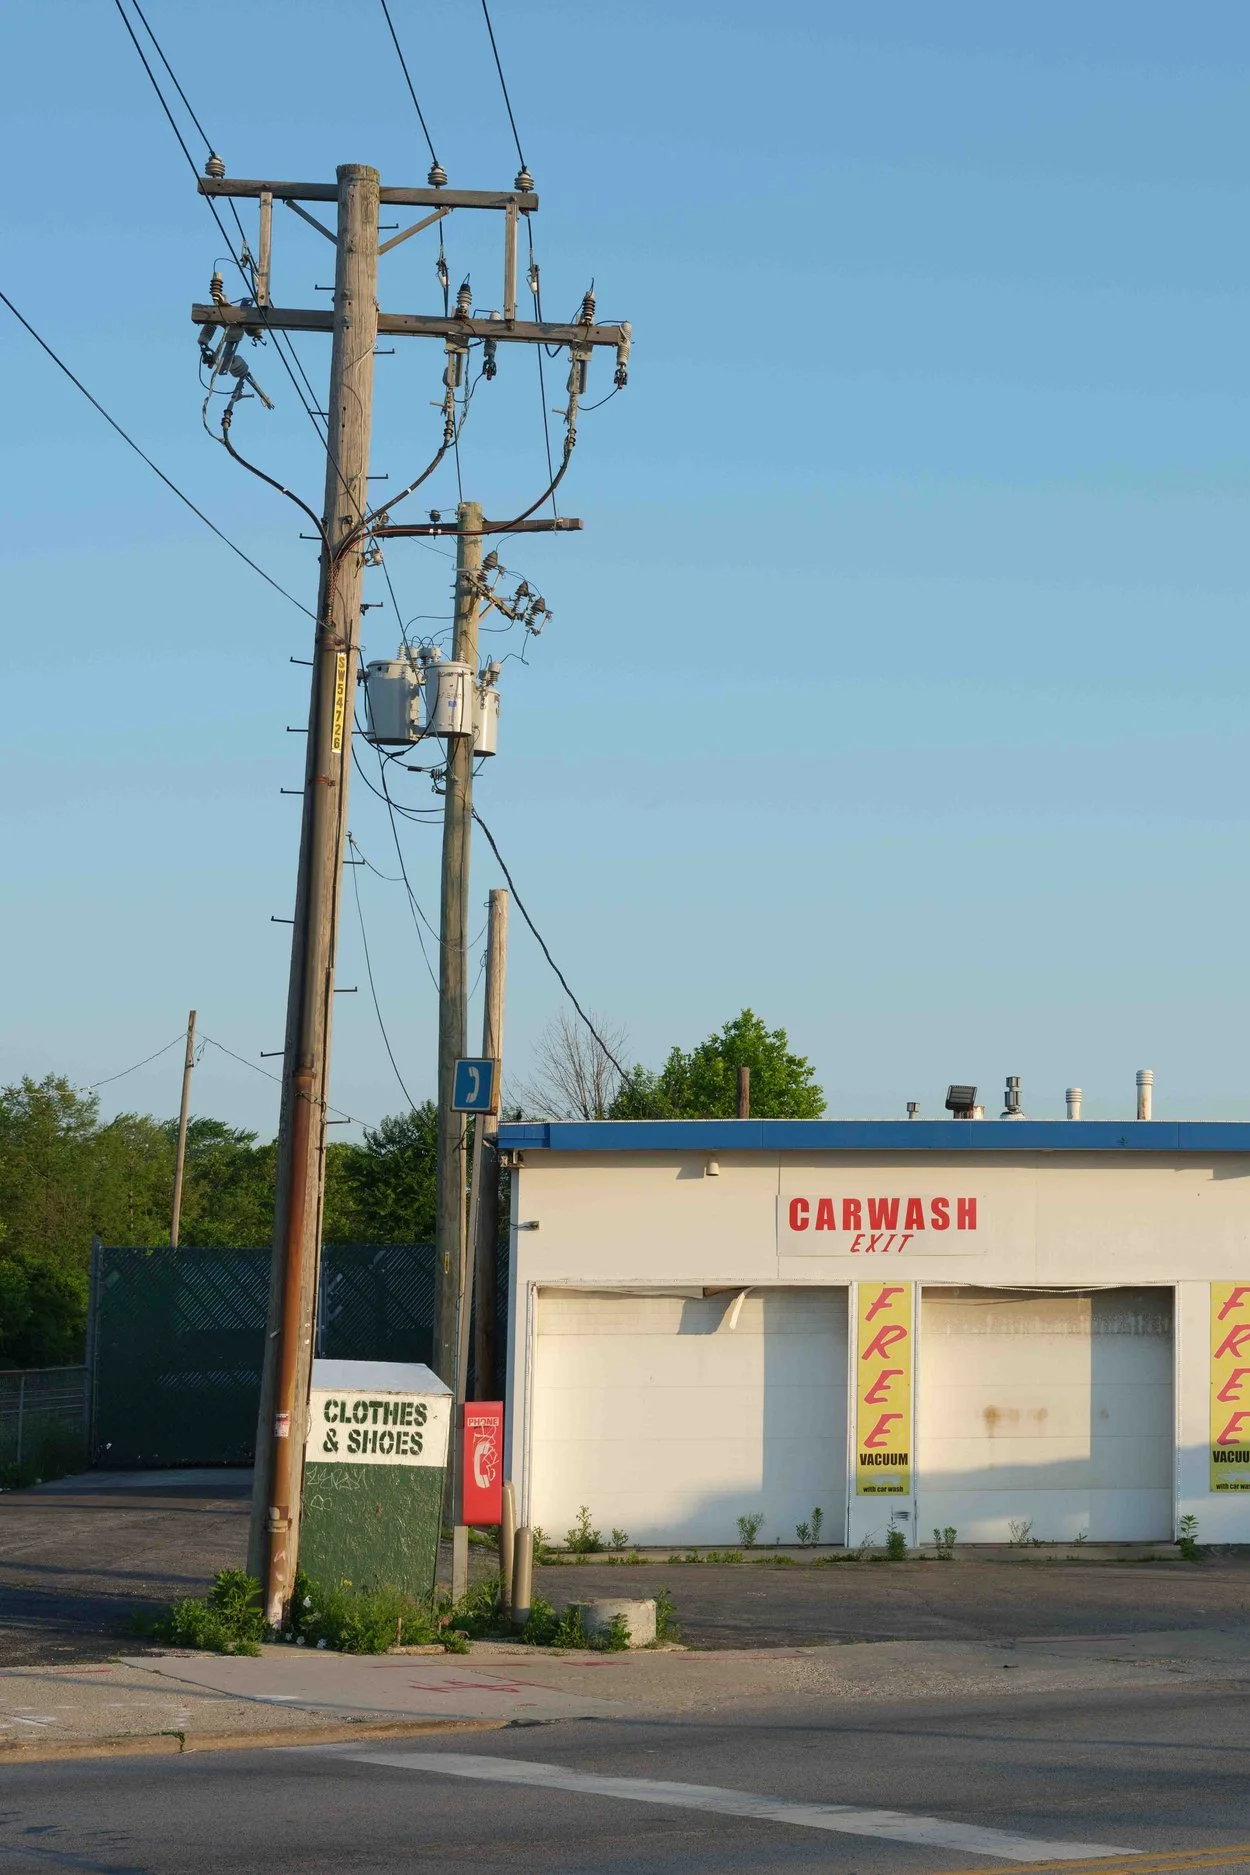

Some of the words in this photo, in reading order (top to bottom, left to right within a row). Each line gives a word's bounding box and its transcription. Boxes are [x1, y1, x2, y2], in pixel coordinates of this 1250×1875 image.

[333, 656, 346, 749] SW54726
[789, 1197, 977, 1232] CARWASH
[850, 1233, 914, 1253] EXIT
[861, 1287, 908, 1449] FREE
[323, 1398, 428, 1427] CLOTHES
[468, 1417, 498, 1426] PHONE
[322, 1427, 339, 1453] &
[346, 1428, 424, 1456] SHOES
[859, 1453, 908, 1466] VACUUM
[1216, 1482, 1229, 1490] with
